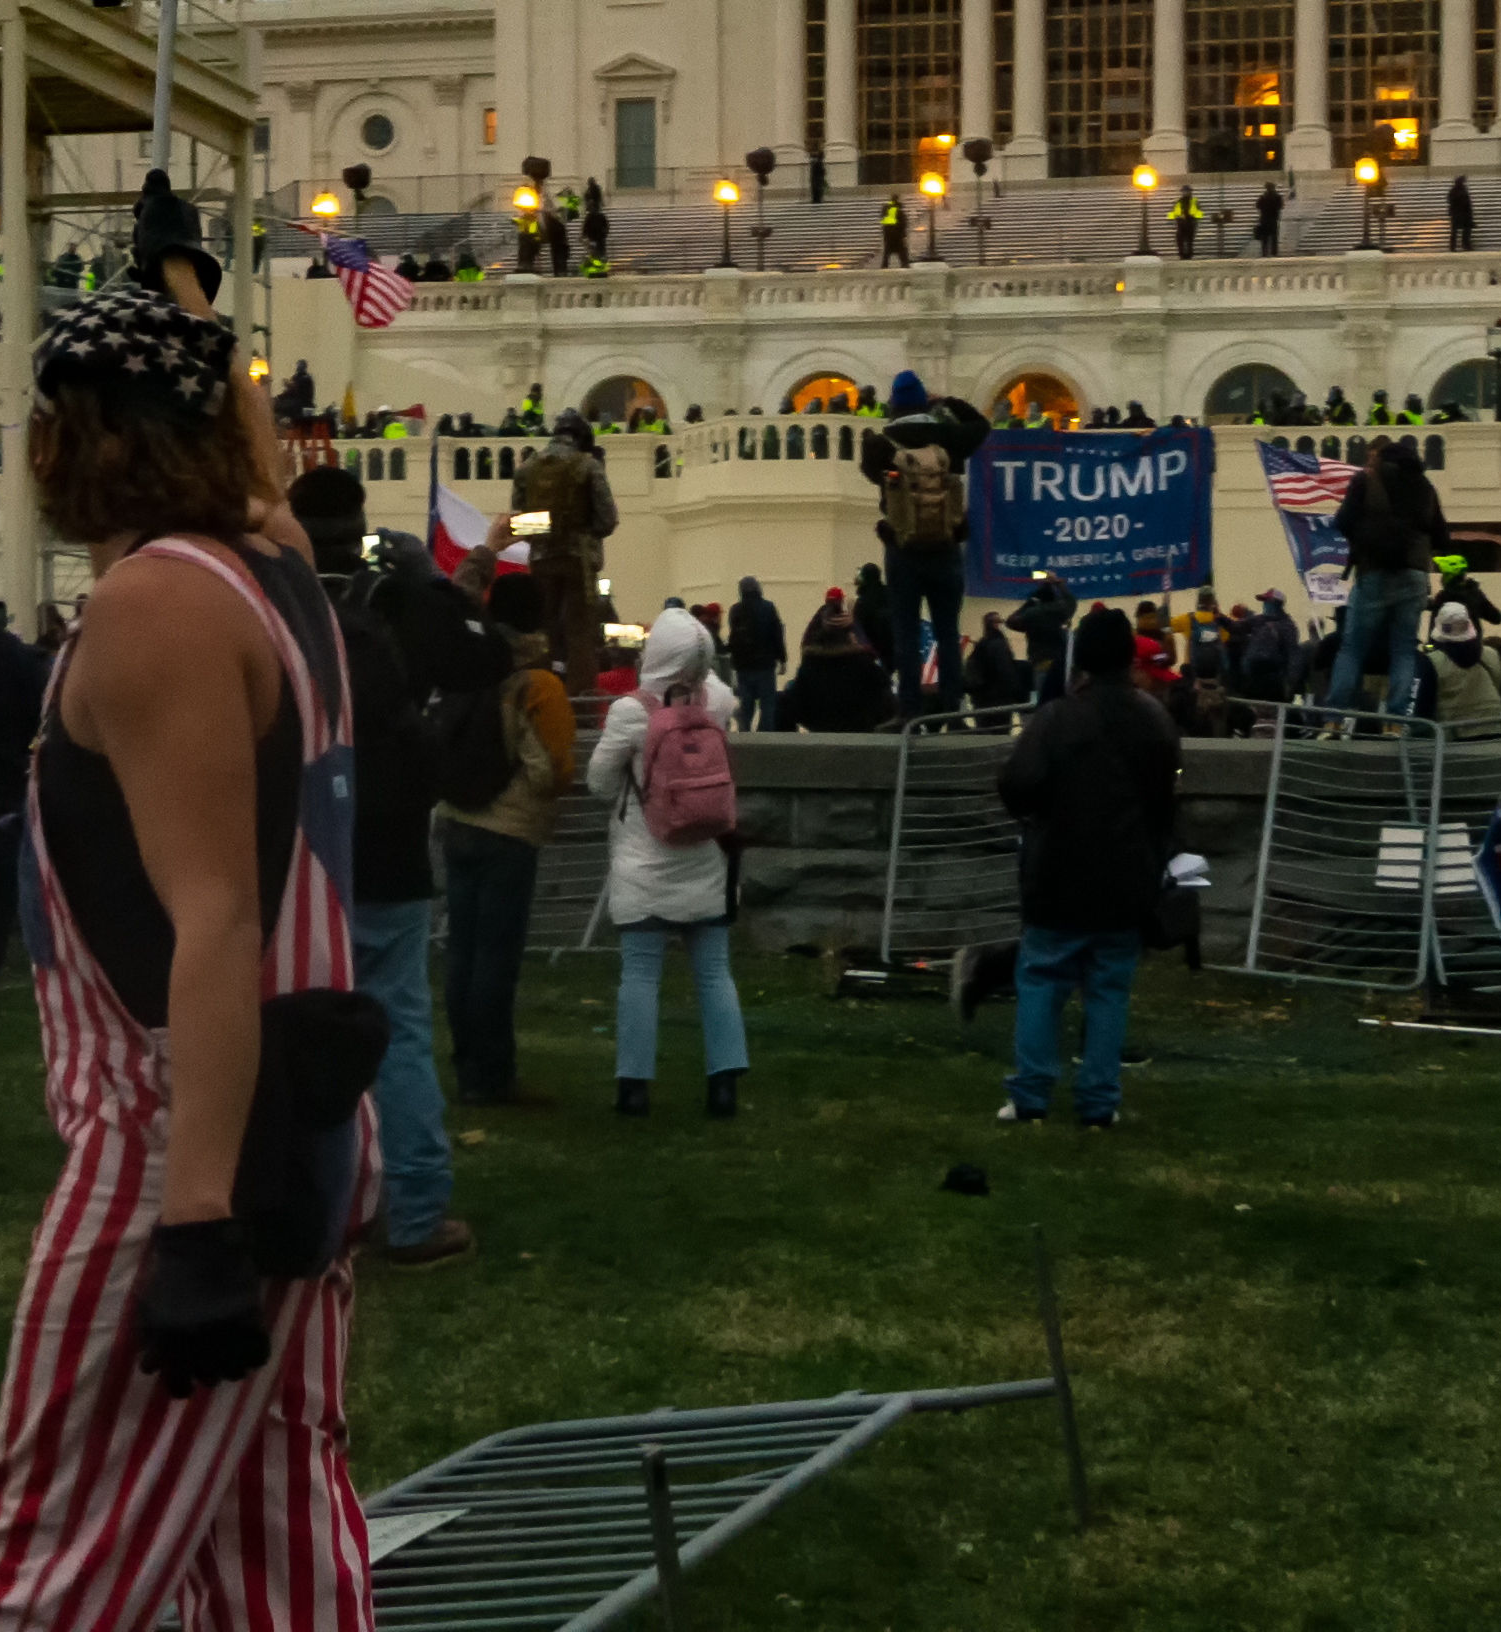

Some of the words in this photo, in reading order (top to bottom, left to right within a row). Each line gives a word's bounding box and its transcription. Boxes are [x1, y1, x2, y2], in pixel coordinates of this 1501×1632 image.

[992, 449, 1188, 502] TRUMP
[1046, 551, 1126, 568] AMERICA
[1131, 541, 1190, 562] GREAT
